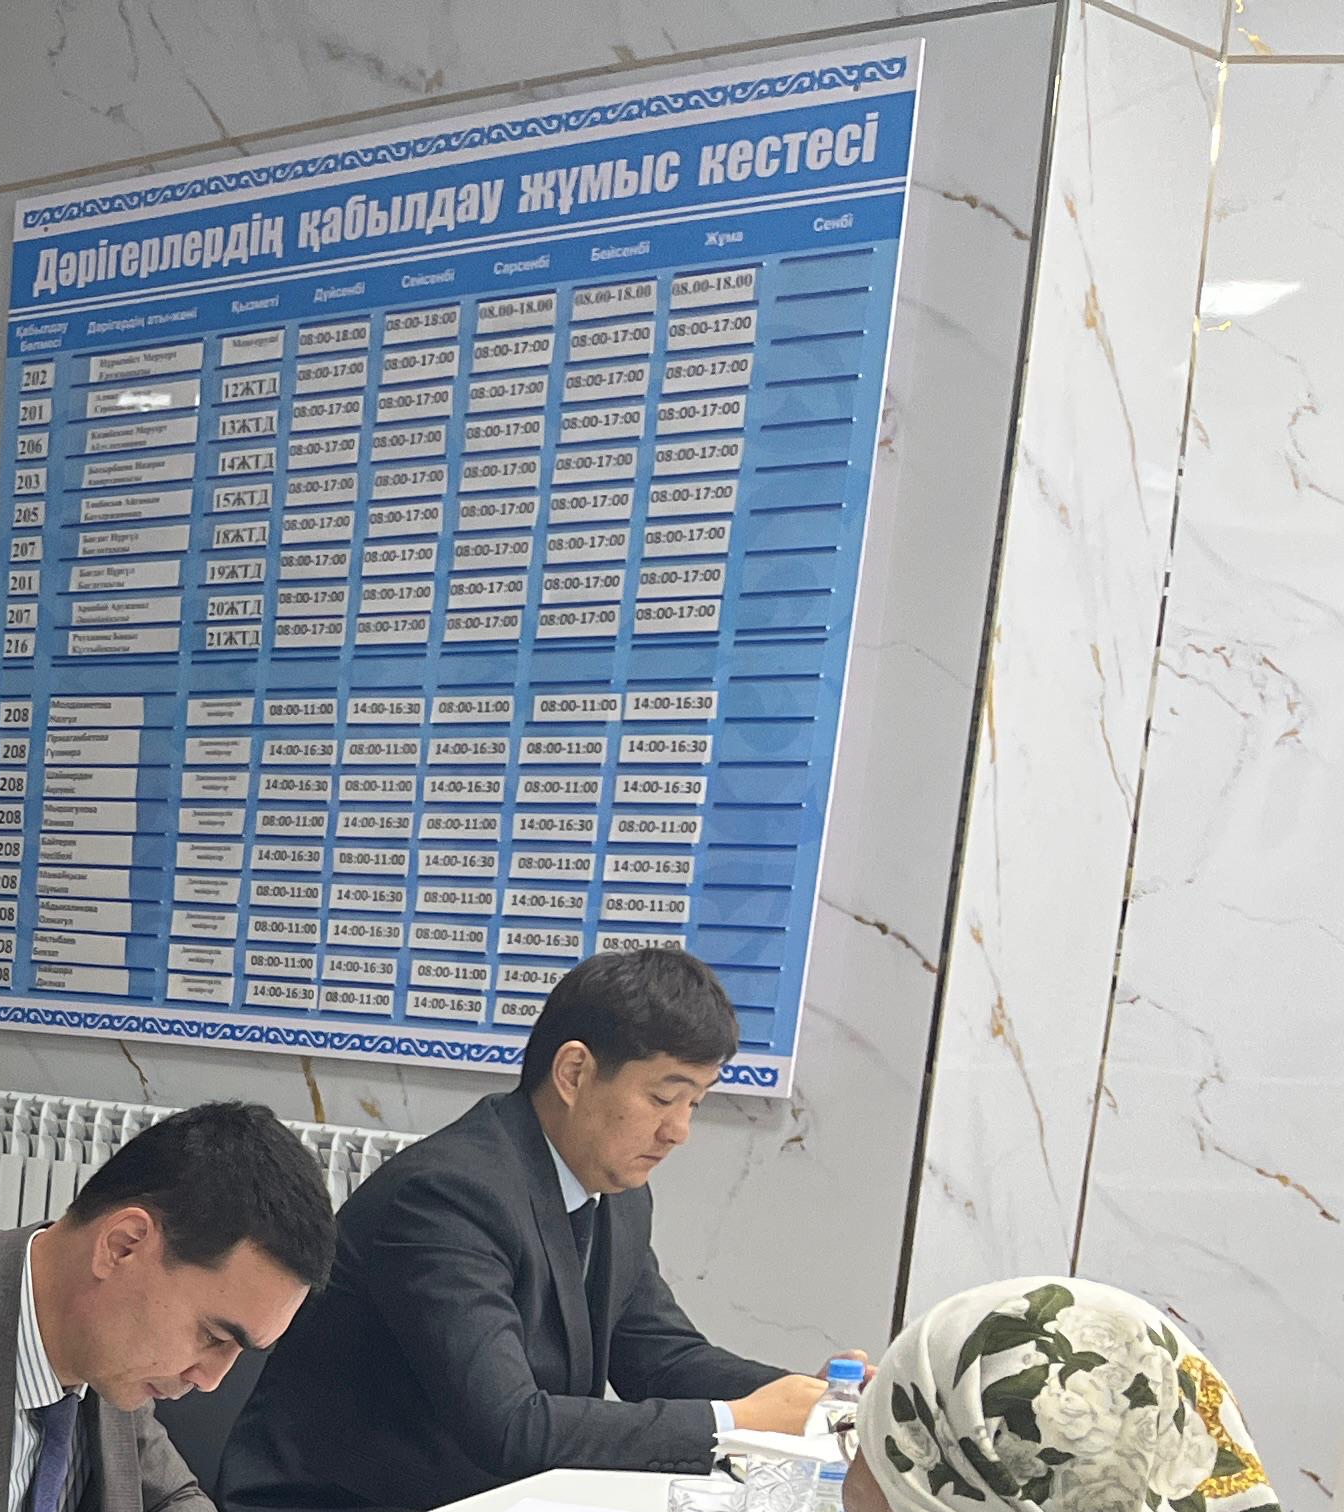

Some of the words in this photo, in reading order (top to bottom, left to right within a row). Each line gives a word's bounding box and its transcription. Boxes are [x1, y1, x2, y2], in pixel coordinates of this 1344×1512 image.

[32, 212, 284, 298] Дәрігерлердің
[298, 178, 505, 253] қабылдау
[517, 150, 681, 215] жұмыс
[698, 111, 879, 186] кестесі
[813, 213, 854, 232] Сенбі
[668, 315, 751, 338] 08:00-17:00
[570, 326, 649, 348] 08:00-17:00
[473, 338, 548, 360] 08:00-17:00
[383, 351, 453, 371] 08:00-17:00
[665, 358, 748, 380] 08:00-17:00
[23, 369, 47, 386] 202
[297, 362, 363, 381] 08:00-17:00
[565, 368, 643, 389] 08:00-17:00
[224, 377, 277, 399] 12ЖТД
[470, 380, 544, 400] 08:00-17:00
[378, 390, 448, 410] 08:00-17:00
[20, 405, 44, 421] 201
[292, 400, 359, 419] 08:00-17:00
[657, 401, 739, 421] 08:00-17:00
[221, 415, 274, 436] 13ЖТД
[561, 410, 639, 430] 08:00-17:00
[465, 420, 539, 440] 08:00-17:00
[19, 439, 42, 455] 206
[289, 438, 355, 456] 08:00-17:00
[372, 430, 441, 448] 08:00-17:00
[655, 443, 737, 463] 08:00-17:00
[220, 452, 274, 473] 14ЖТД
[462, 460, 536, 479] 08:00-17:00
[555, 452, 632, 471] 08:00-17:00
[16, 474, 40, 489] 203
[288, 477, 354, 494] 08:00-17:00
[374, 469, 444, 487] 08:00-17:00
[215, 489, 268, 509] 15ЖТД
[550, 493, 627, 511] 08:00-17:00
[650, 485, 732, 503] 08:00-17:00
[15, 507, 38, 523] 205
[369, 507, 438, 524] 08:00-17:00
[460, 501, 534, 518] 08:00-17:00
[284, 515, 349, 531] 08:00-17:00
[214, 526, 267, 545] 18ЖТД
[547, 534, 624, 551] 08:00-17:00
[644, 526, 725, 544] 08:00-17:00
[12, 542, 35, 557] 207
[363, 547, 432, 563] 08:00-17:00
[455, 541, 528, 558] 08:00-17:00
[280, 552, 345, 568] 08:00-17:00
[210, 562, 262, 581] 19ЖТД
[639, 568, 720, 585] 08:00-17:00
[10, 576, 33, 590] 201
[449, 580, 522, 596] 08:00-17:00
[543, 574, 620, 591] 08:00-17:00
[278, 590, 343, 604] 08:00-17:00
[361, 586, 430, 601] 08:00-17:00
[7, 609, 30, 623] 207
[209, 599, 262, 617] 20ЖТД
[634, 604, 715, 620] 08:00-17:00
[356, 619, 425, 633] 08:00-17:00
[446, 615, 518, 630] 08:00-17:00
[539, 610, 615, 626] 08:00-17:00
[276, 622, 341, 636] 08:00-17:00
[5, 639, 28, 653] 216
[208, 629, 260, 647] 21ЖТД
[268, 703, 333, 715] 08:00-11:00
[353, 702, 420, 715] 14:00-16:30
[438, 700, 510, 713] 08:00-11:00
[540, 699, 617, 711] 08:00-11:00
[633, 696, 713, 710] 14:00-16:30
[4, 708, 29, 722] 208
[2, 745, 27, 759] 208
[269, 744, 333, 756] 14:00-16:30
[349, 743, 417, 754] 08:00-11:00
[435, 742, 506, 754] 14:00-16:30
[526, 742, 602, 753] 08:00-11:00
[628, 740, 707, 752] 14:00-16:30
[0, 777, 24, 791] 208
[265, 779, 328, 791] 14:00-16:30
[344, 780, 412, 791] 08:00-11:00
[430, 780, 500, 793] 14:00-16:30
[523, 781, 599, 793] 08:00-11:00
[622, 780, 701, 794] 14:00-16:30
[260, 815, 325, 827] 08:00-11:00
[344, 816, 410, 829] 14:00-16:30
[426, 817, 497, 830] 08:00-11:00
[519, 818, 593, 832] 14:00-16:30
[617, 820, 697, 833] 08:00-11:00
[257, 849, 320, 862] 14:00-16:30
[338, 852, 405, 865] 08:00-11:00
[425, 854, 495, 868] 14:00-16:30
[516, 857, 591, 870] 08:00-11:00
[613, 859, 691, 874] 14:00-16:30
[255, 885, 319, 898] 08:00-11:00
[337, 888, 403, 903] 14:00-16:30
[422, 891, 493, 905] 08:00-11:00
[511, 894, 584, 909] 14:00-16:30
[606, 898, 685, 913] 08:00-11:00
[253, 920, 317, 934] 08:00-11:00
[334, 924, 400, 939] 14:00-16:30
[414, 927, 484, 942] 08:00-11:00
[507, 932, 580, 948] 14:00-16:30
[249, 954, 313, 969] 08:00-11:00
[329, 959, 394, 975] 14:00-16:30
[416, 964, 487, 980] 08:00-11:00
[504, 969, 563, 985] 14:00-16:
[252, 985, 315, 1000] 14:00-16:30
[323, 990, 390, 1006] 08:00-11:00
[413, 996, 482, 1013] 14:00-16:30
[500, 1002, 543, 1016] 08:00-
